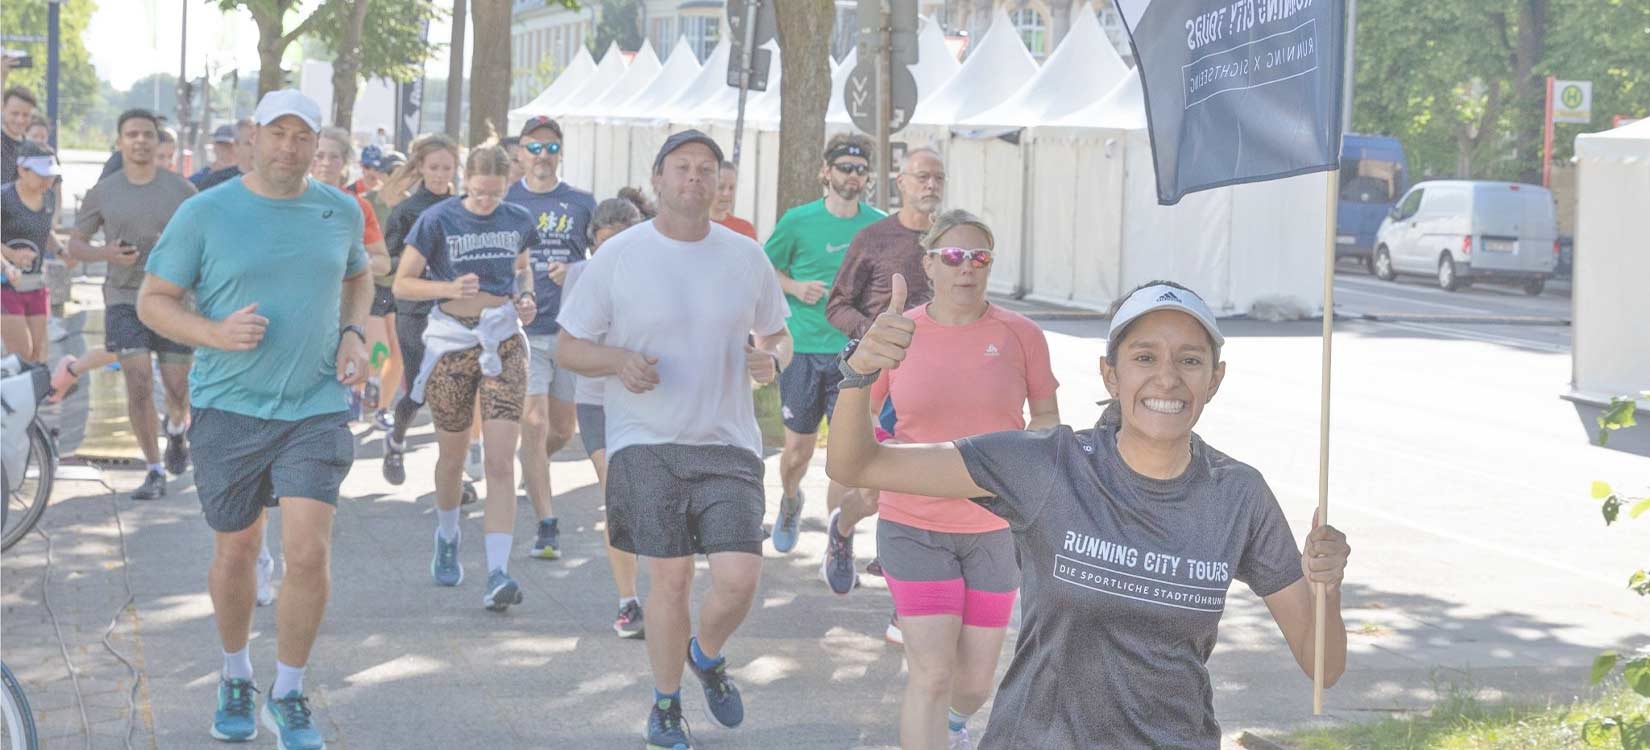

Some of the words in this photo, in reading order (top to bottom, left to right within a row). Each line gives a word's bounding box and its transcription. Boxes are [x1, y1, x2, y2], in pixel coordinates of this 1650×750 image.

[1063, 530, 1138, 568] RUNNING
[1144, 552, 1181, 576] CITY
[1187, 559, 1229, 582] TOURS
[1059, 564, 1076, 577] DIE
[1080, 571, 1149, 595] SPORTLICHE
